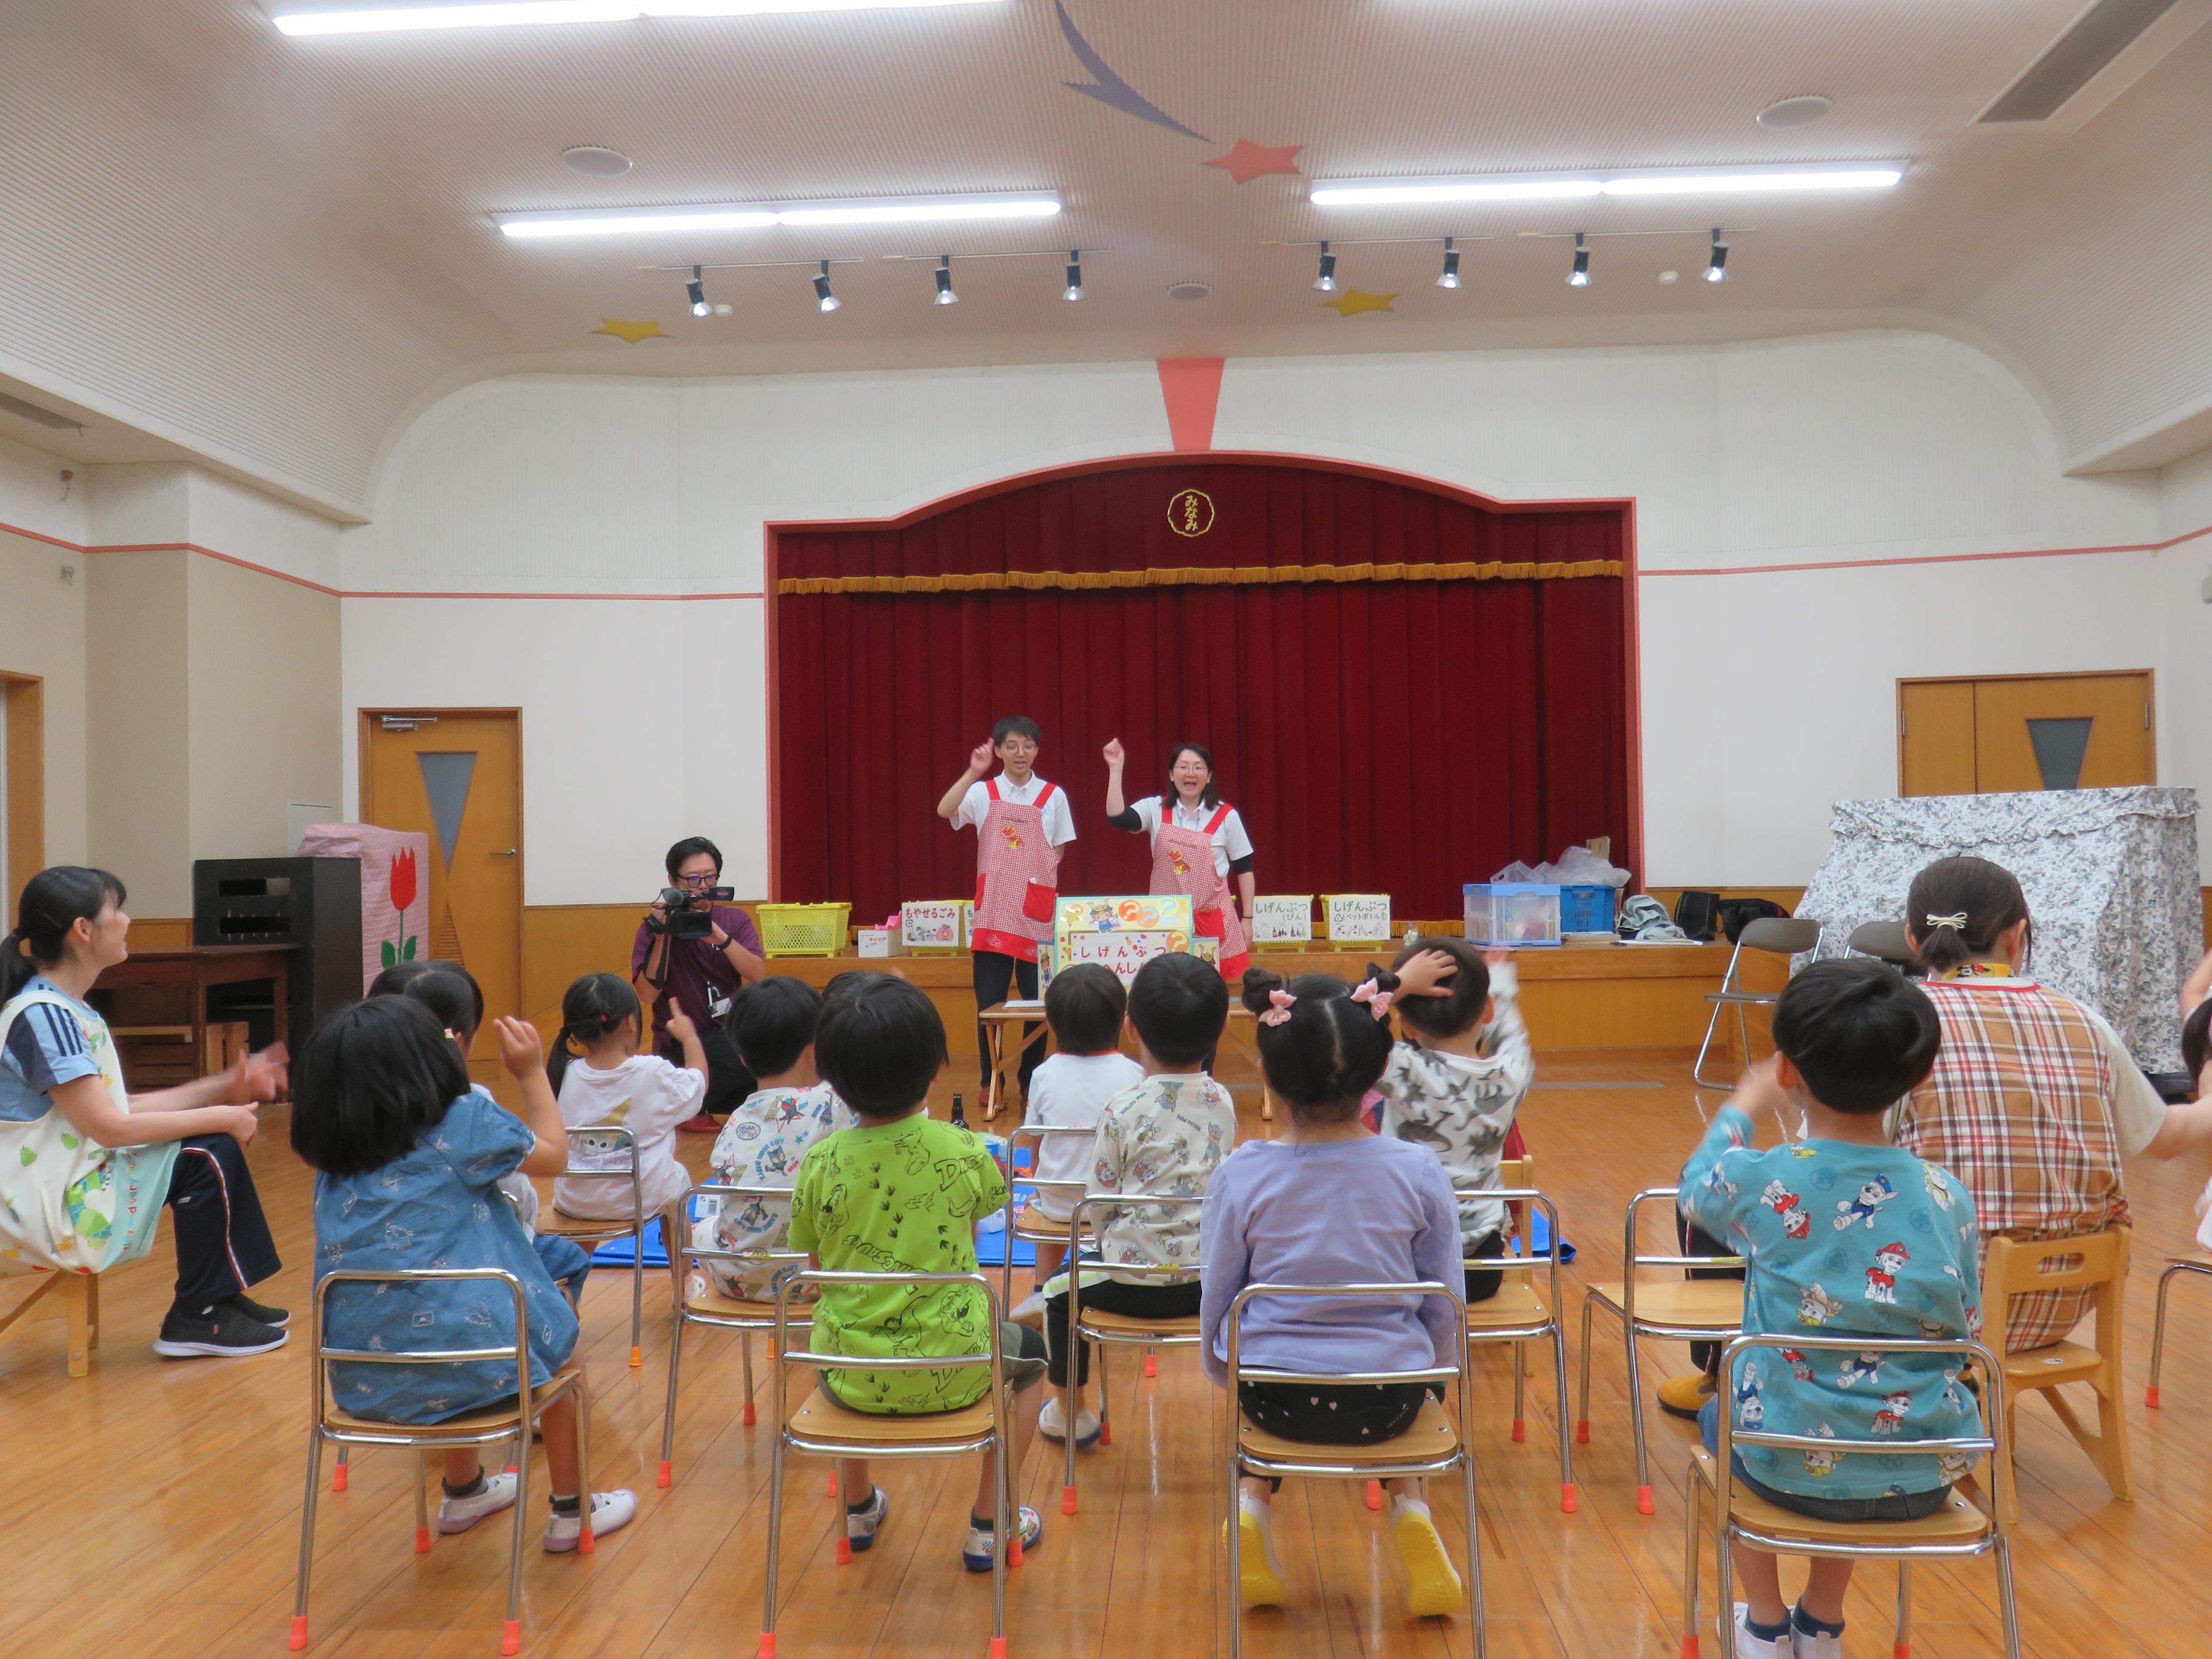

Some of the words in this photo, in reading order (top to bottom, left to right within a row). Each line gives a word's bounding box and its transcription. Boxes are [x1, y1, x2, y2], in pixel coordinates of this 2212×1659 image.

[1184, 495, 1198, 531] みなみ
[1255, 902, 1308, 913] しげんぶつ
[1334, 901, 1387, 912] しげんぶつ
[906, 908, 956, 919] もやせるごみ
[1081, 945, 1167, 958] しげんぶつ
